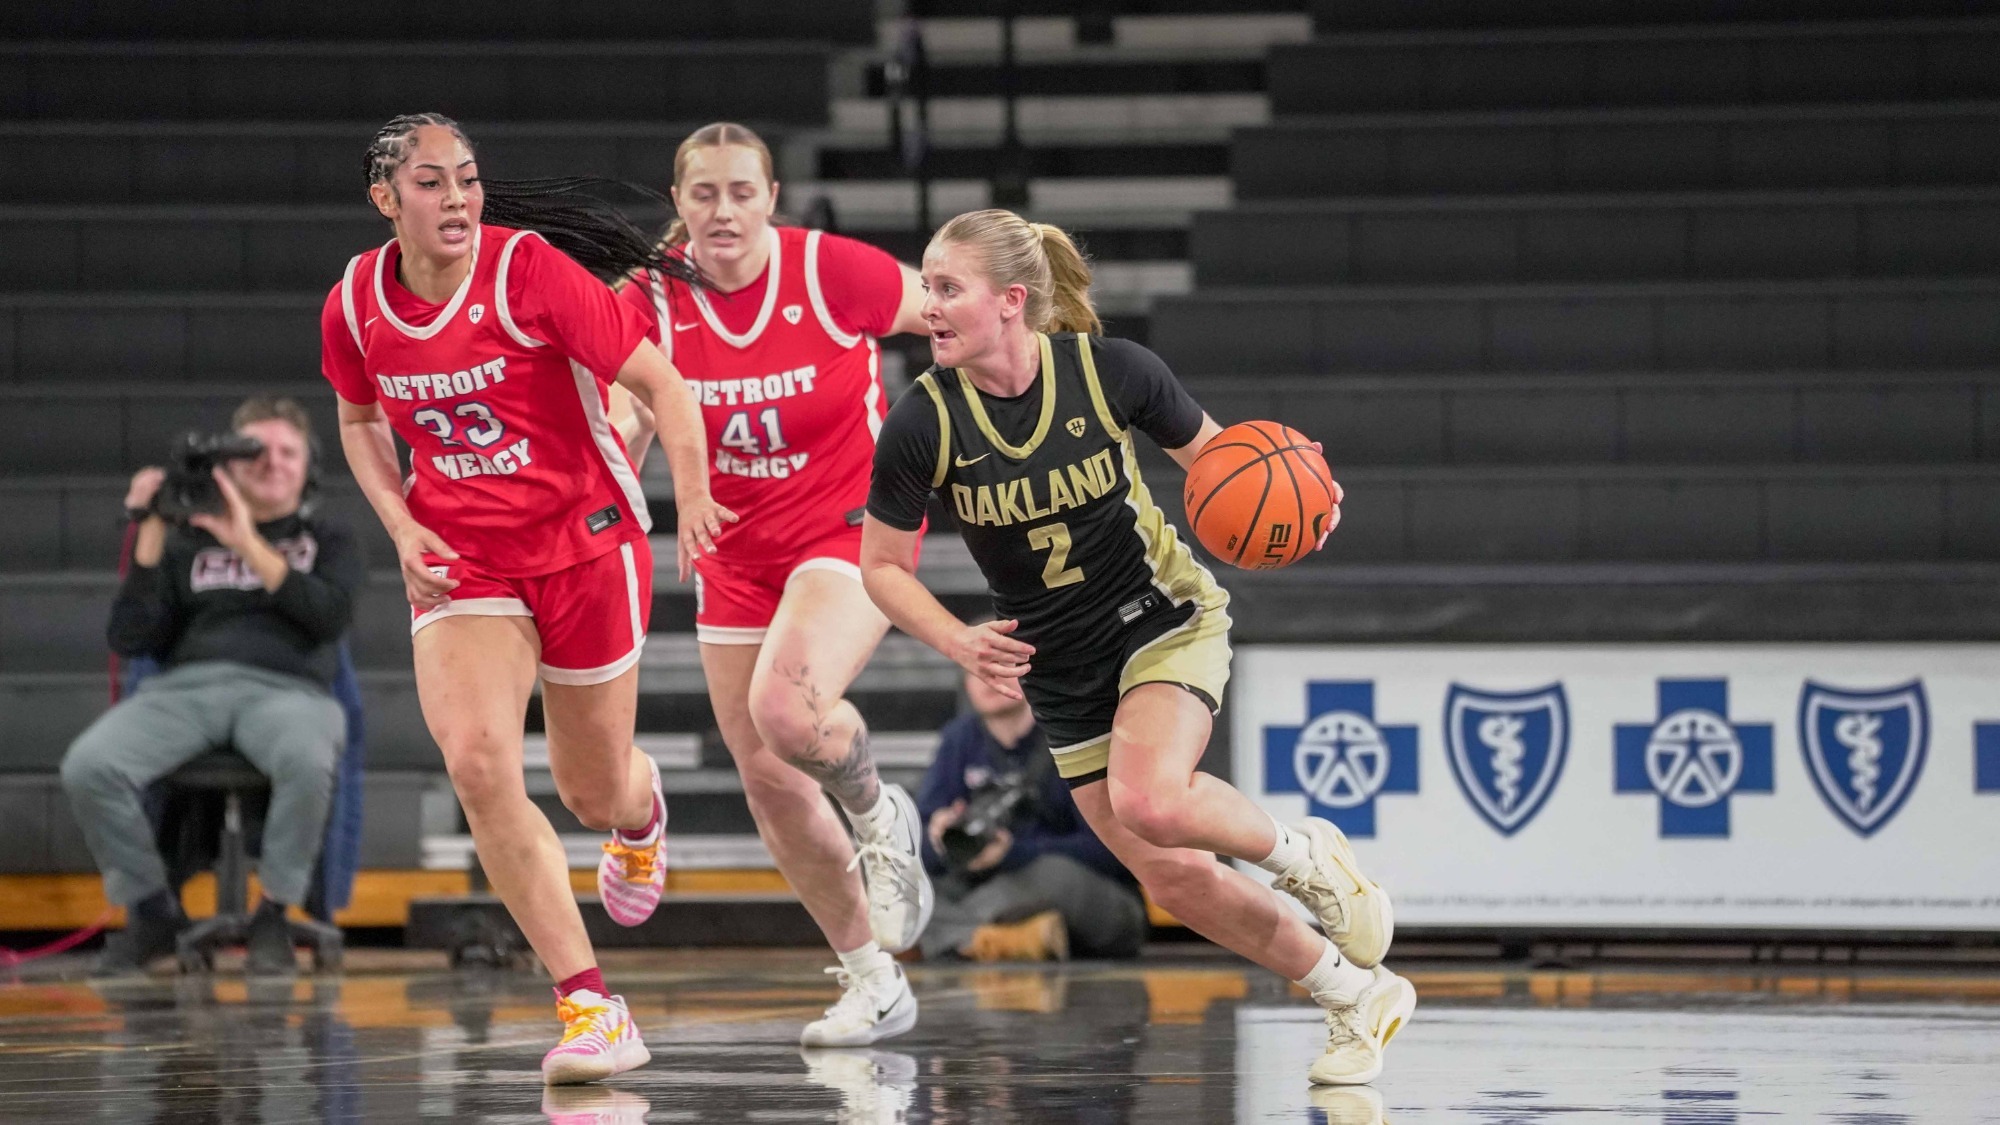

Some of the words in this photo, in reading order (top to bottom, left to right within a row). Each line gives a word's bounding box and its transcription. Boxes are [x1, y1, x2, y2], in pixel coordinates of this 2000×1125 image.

[376, 356, 507, 400] DETROIT
[721, 407, 788, 455] 41
[432, 438, 532, 480] MERCY
[951, 448, 1117, 527] OAKLAND
[1027, 522, 1085, 589] 2
